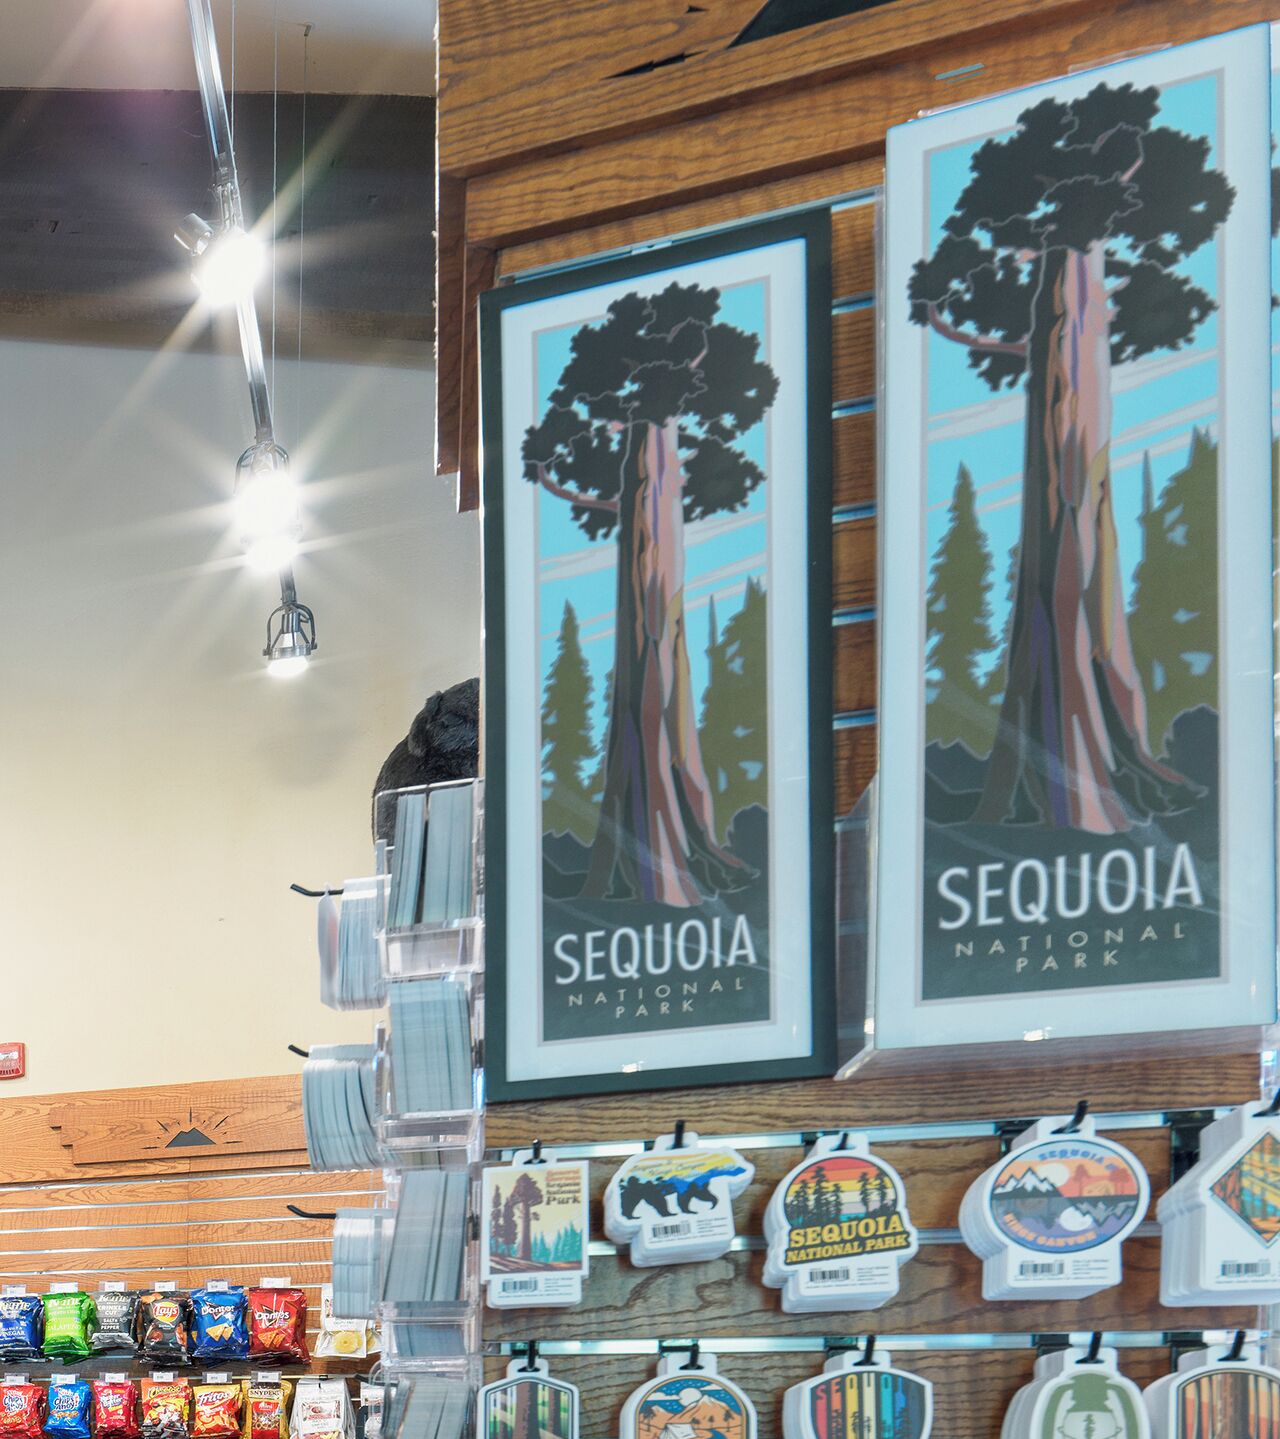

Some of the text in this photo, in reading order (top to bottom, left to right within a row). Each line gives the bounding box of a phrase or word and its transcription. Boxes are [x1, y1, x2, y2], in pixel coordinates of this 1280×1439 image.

[938, 843, 1203, 930] SEQUOIA
[554, 914, 757, 985] SEQUOIA
[956, 923, 1184, 957] NATIONAL
[1016, 950, 1118, 973] PARK
[569, 977, 744, 1007] NATIONAL
[616, 1000, 693, 1018] PARK
[789, 1215, 904, 1248] SEQUOIA
[785, 1234, 909, 1264] NATIONAL PARK
